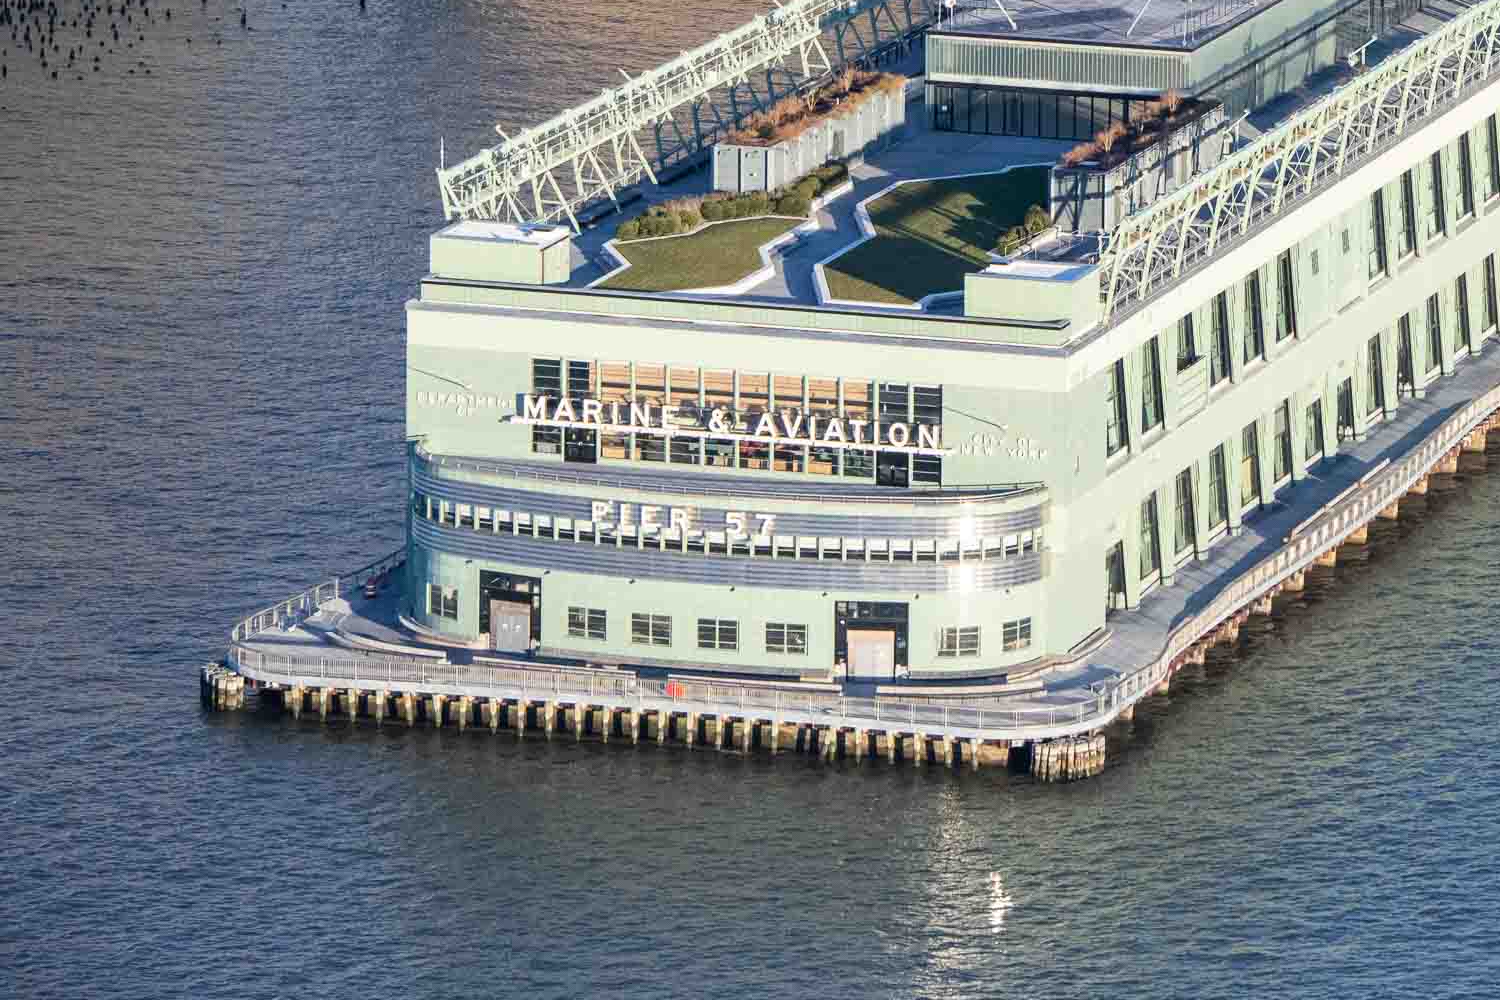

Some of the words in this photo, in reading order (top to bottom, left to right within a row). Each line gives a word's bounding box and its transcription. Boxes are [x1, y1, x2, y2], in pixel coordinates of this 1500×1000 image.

[522, 394, 680, 428] MARINE
[708, 407, 732, 433] &
[753, 412, 941, 448] AVIATION
[591, 500, 689, 537] PIER
[725, 511, 777, 539] 57
